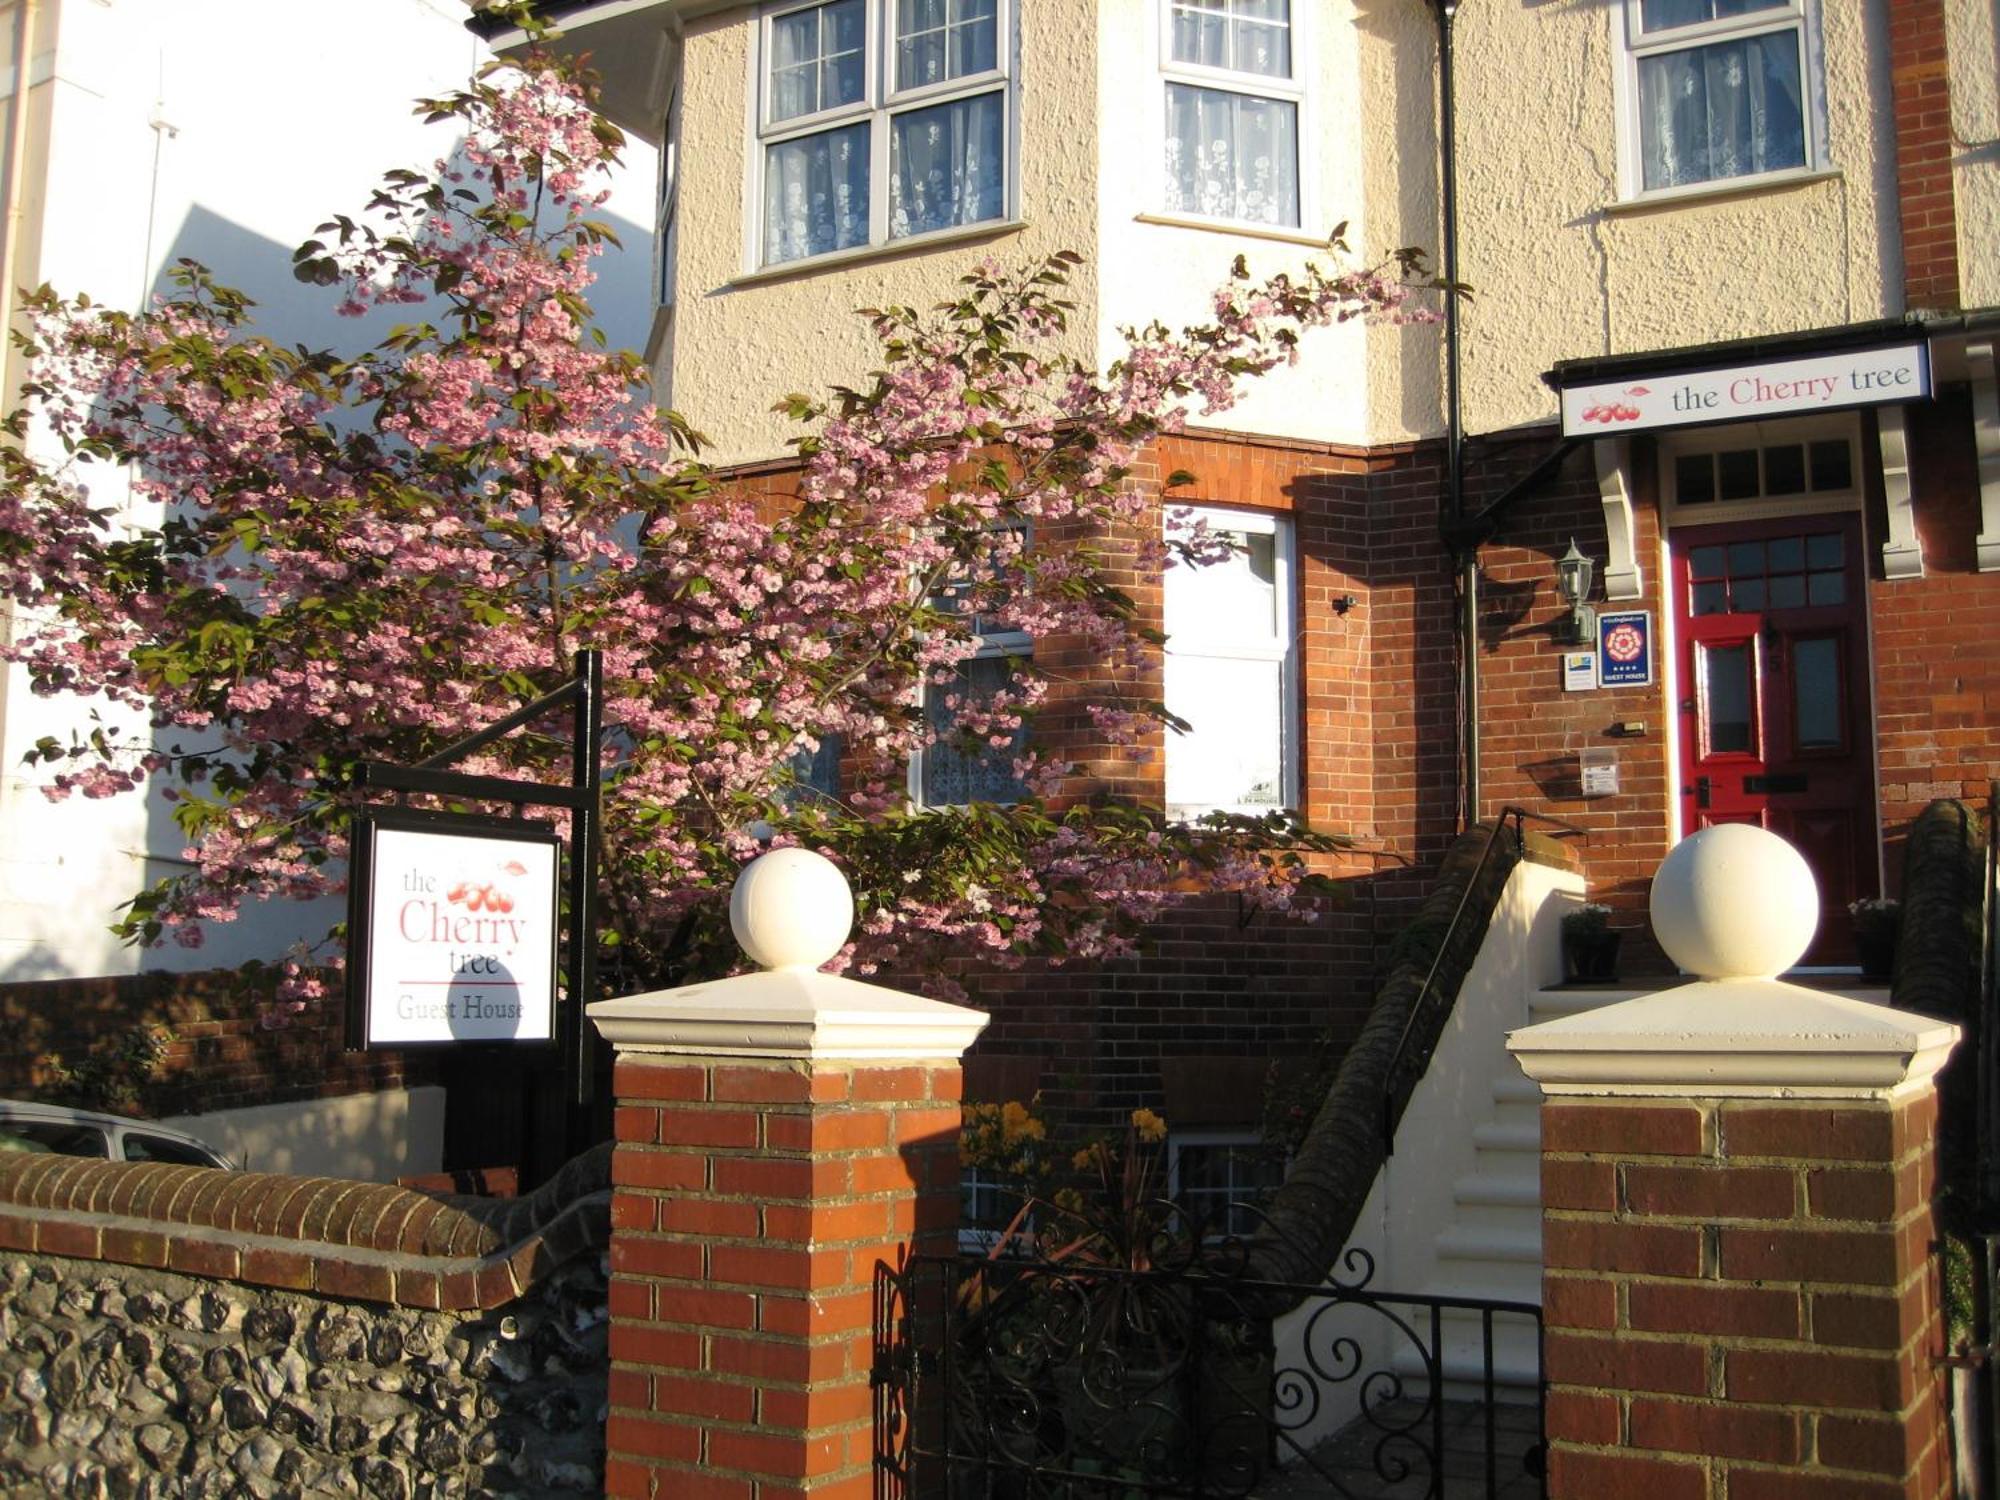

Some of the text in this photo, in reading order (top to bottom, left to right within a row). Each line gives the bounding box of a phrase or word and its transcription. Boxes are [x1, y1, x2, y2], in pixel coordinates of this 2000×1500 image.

[1671, 364, 1912, 412] the Cherry tree
[403, 867, 437, 894] the
[399, 899, 526, 955] Cherry
[449, 949, 500, 975] tree
[397, 995, 525, 1020] Guest House
